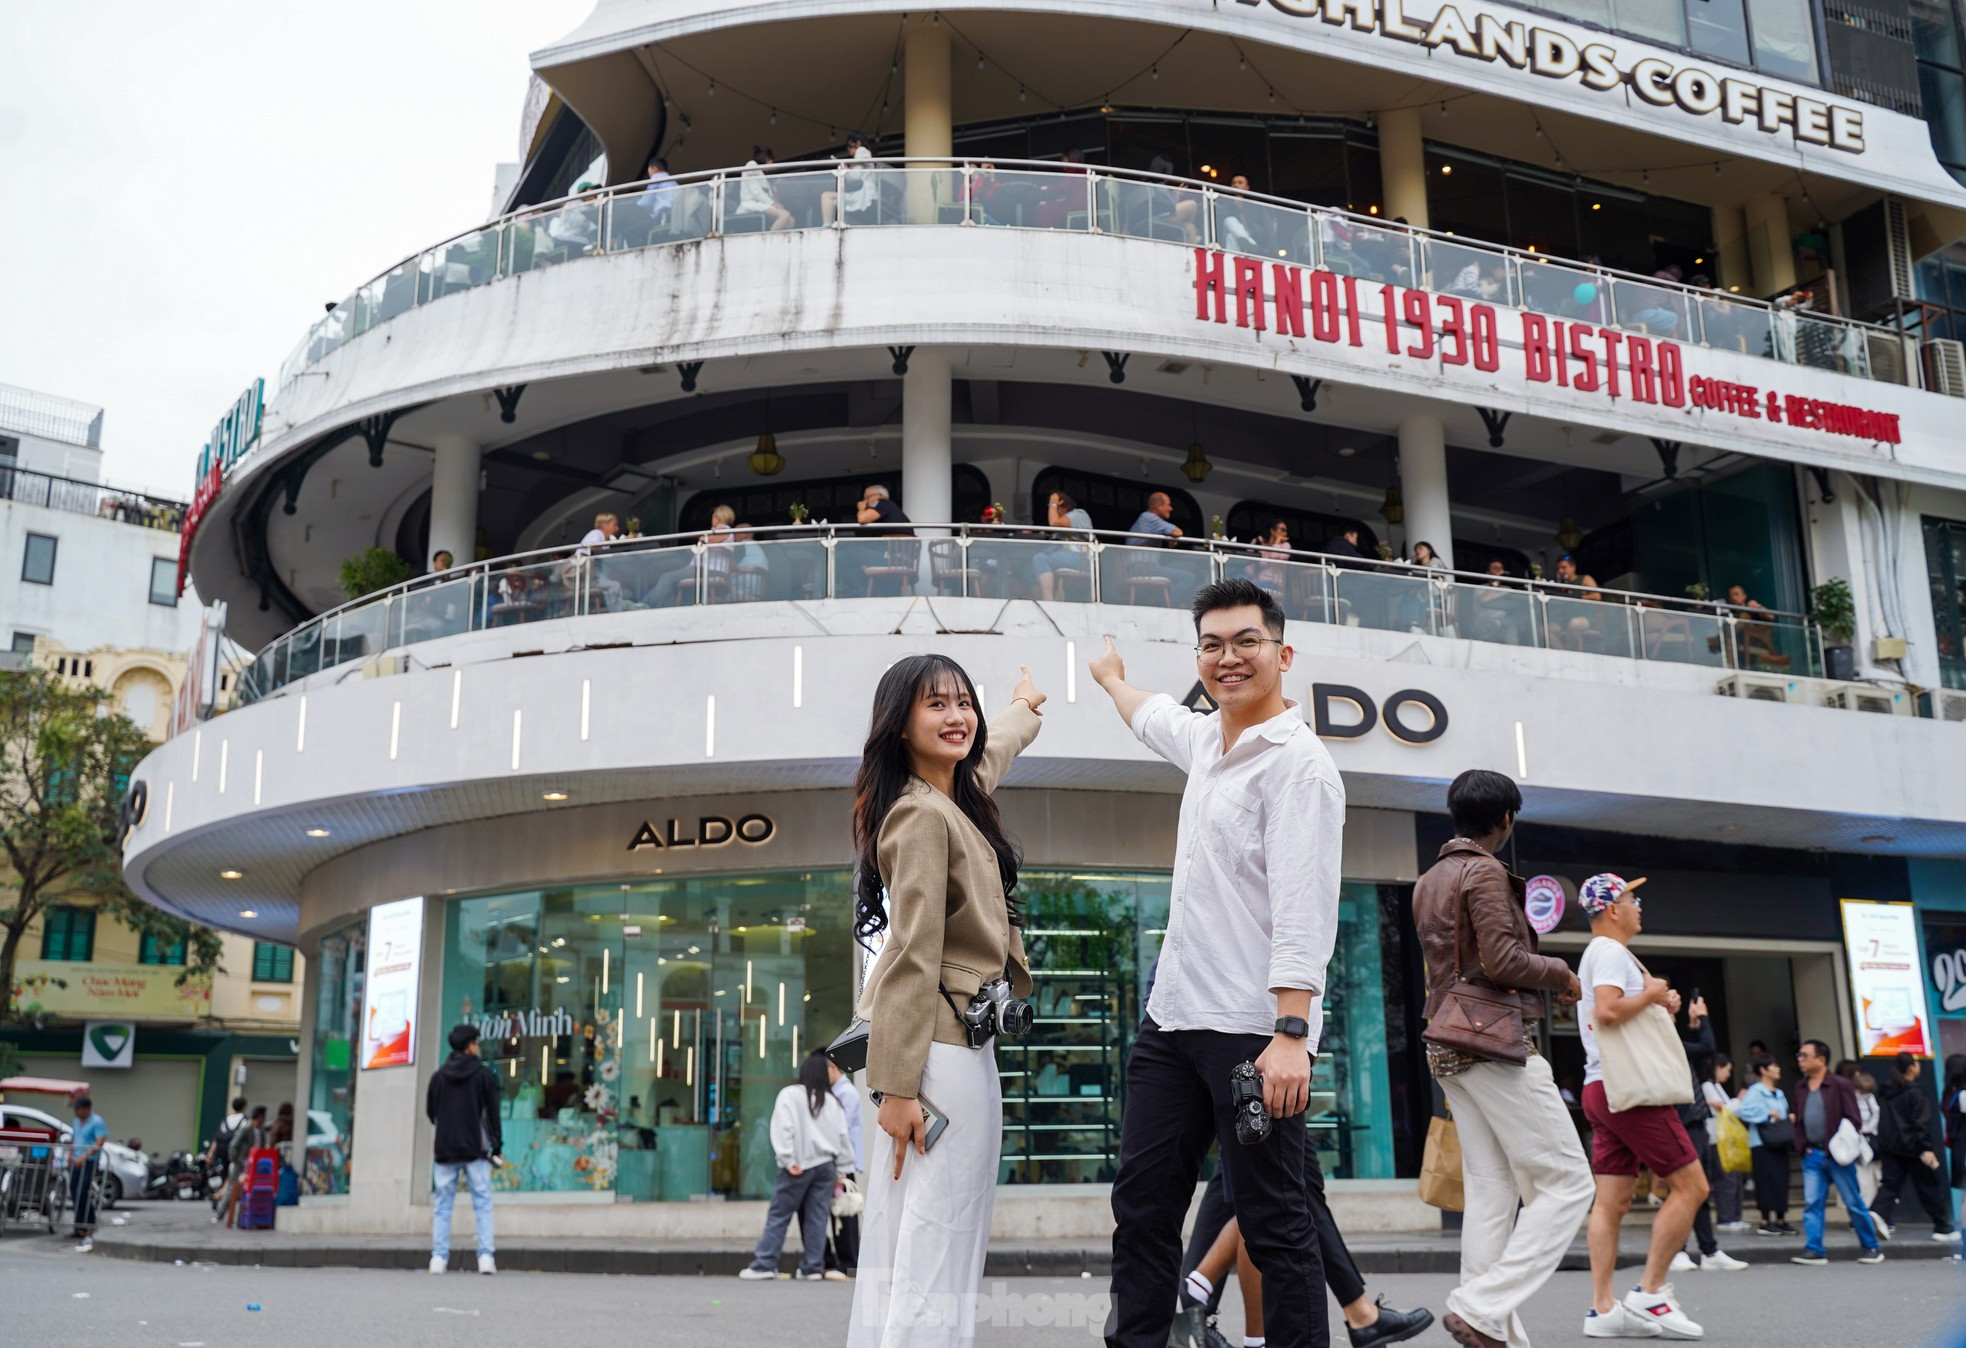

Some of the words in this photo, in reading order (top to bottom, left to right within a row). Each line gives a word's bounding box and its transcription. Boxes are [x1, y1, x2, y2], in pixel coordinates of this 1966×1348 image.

[1631, 58, 1865, 155] COFFEE
[1194, 247, 1364, 348] HANOI
[1378, 283, 1499, 373] 1930
[1520, 311, 1686, 409] BISTRO
[1689, 373, 1761, 419] COFFEE
[1766, 390, 1783, 423] &
[1784, 394, 1902, 444] RESTAURANT
[627, 813, 774, 850] ALDO
